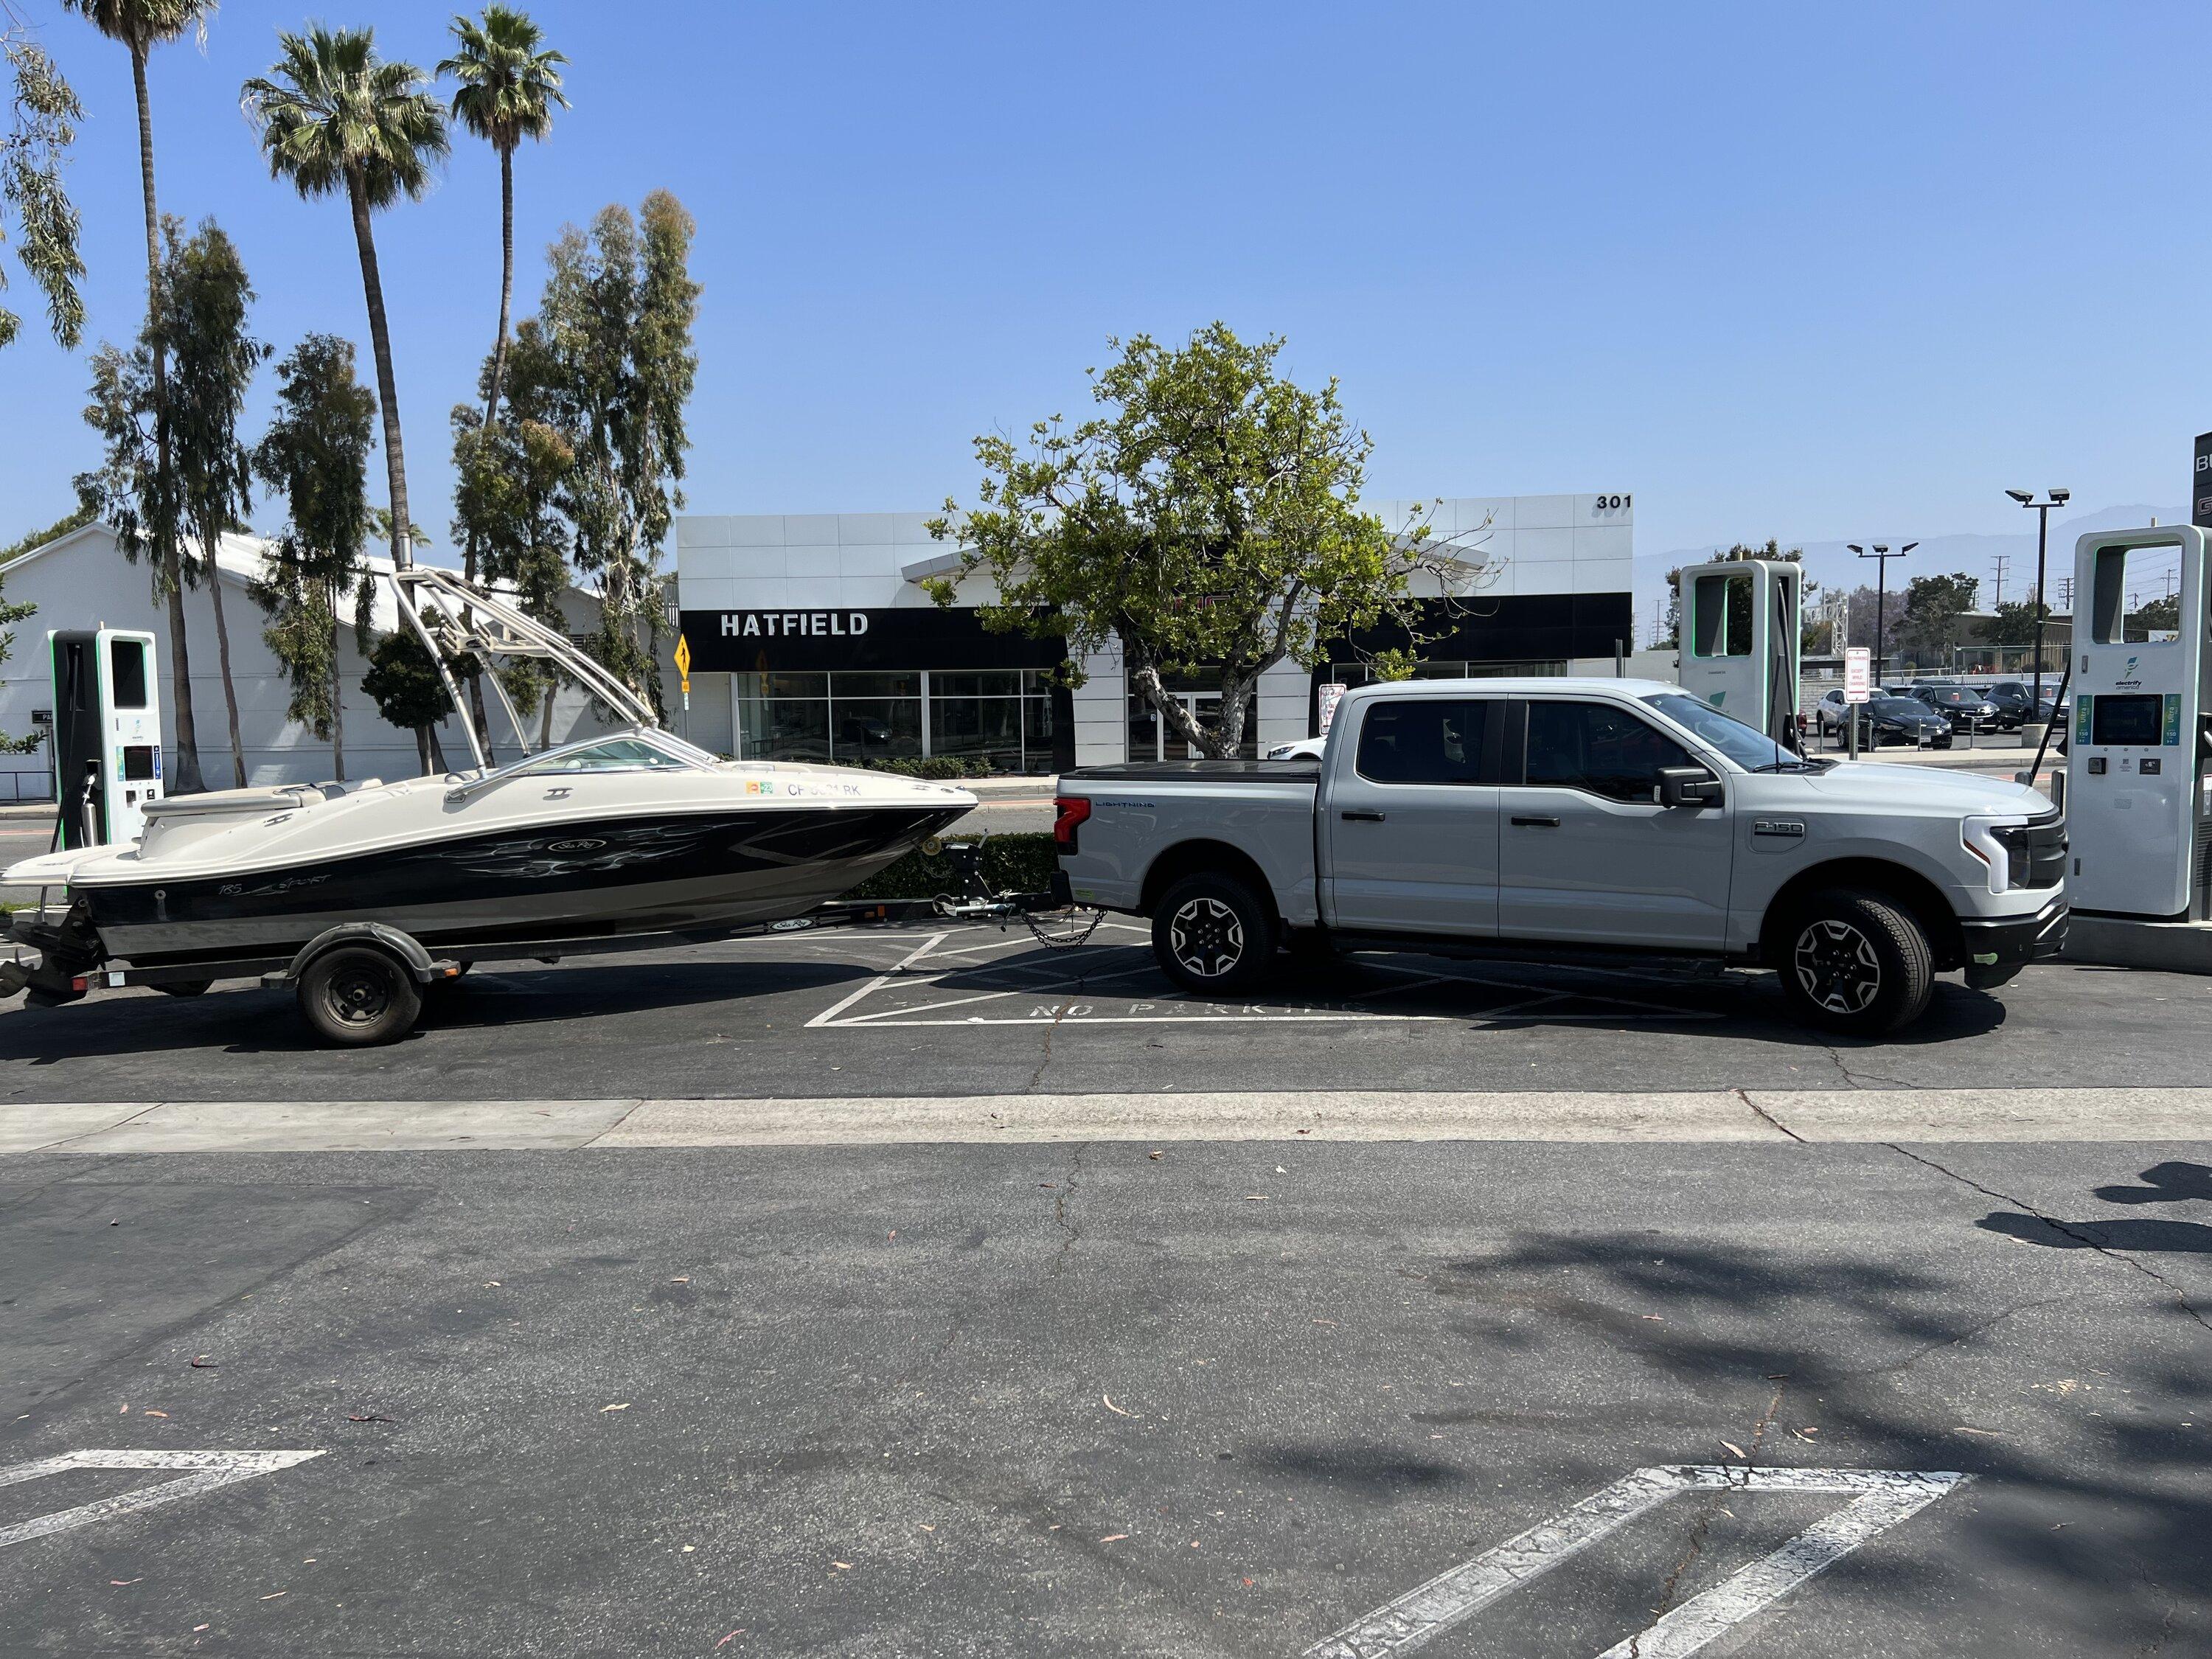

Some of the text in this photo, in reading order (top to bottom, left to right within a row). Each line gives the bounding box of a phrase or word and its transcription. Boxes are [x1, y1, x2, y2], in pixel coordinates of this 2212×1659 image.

[1596, 495, 1631, 509] 301
[720, 613, 869, 636] HATFIELD
[787, 784, 804, 796] CF
[843, 785, 862, 796] RK
[1755, 821, 1804, 832] F-150
[577, 841, 596, 849] Ray
[218, 883, 243, 895] 185
[1029, 1001, 1368, 1017] NO PARKING
